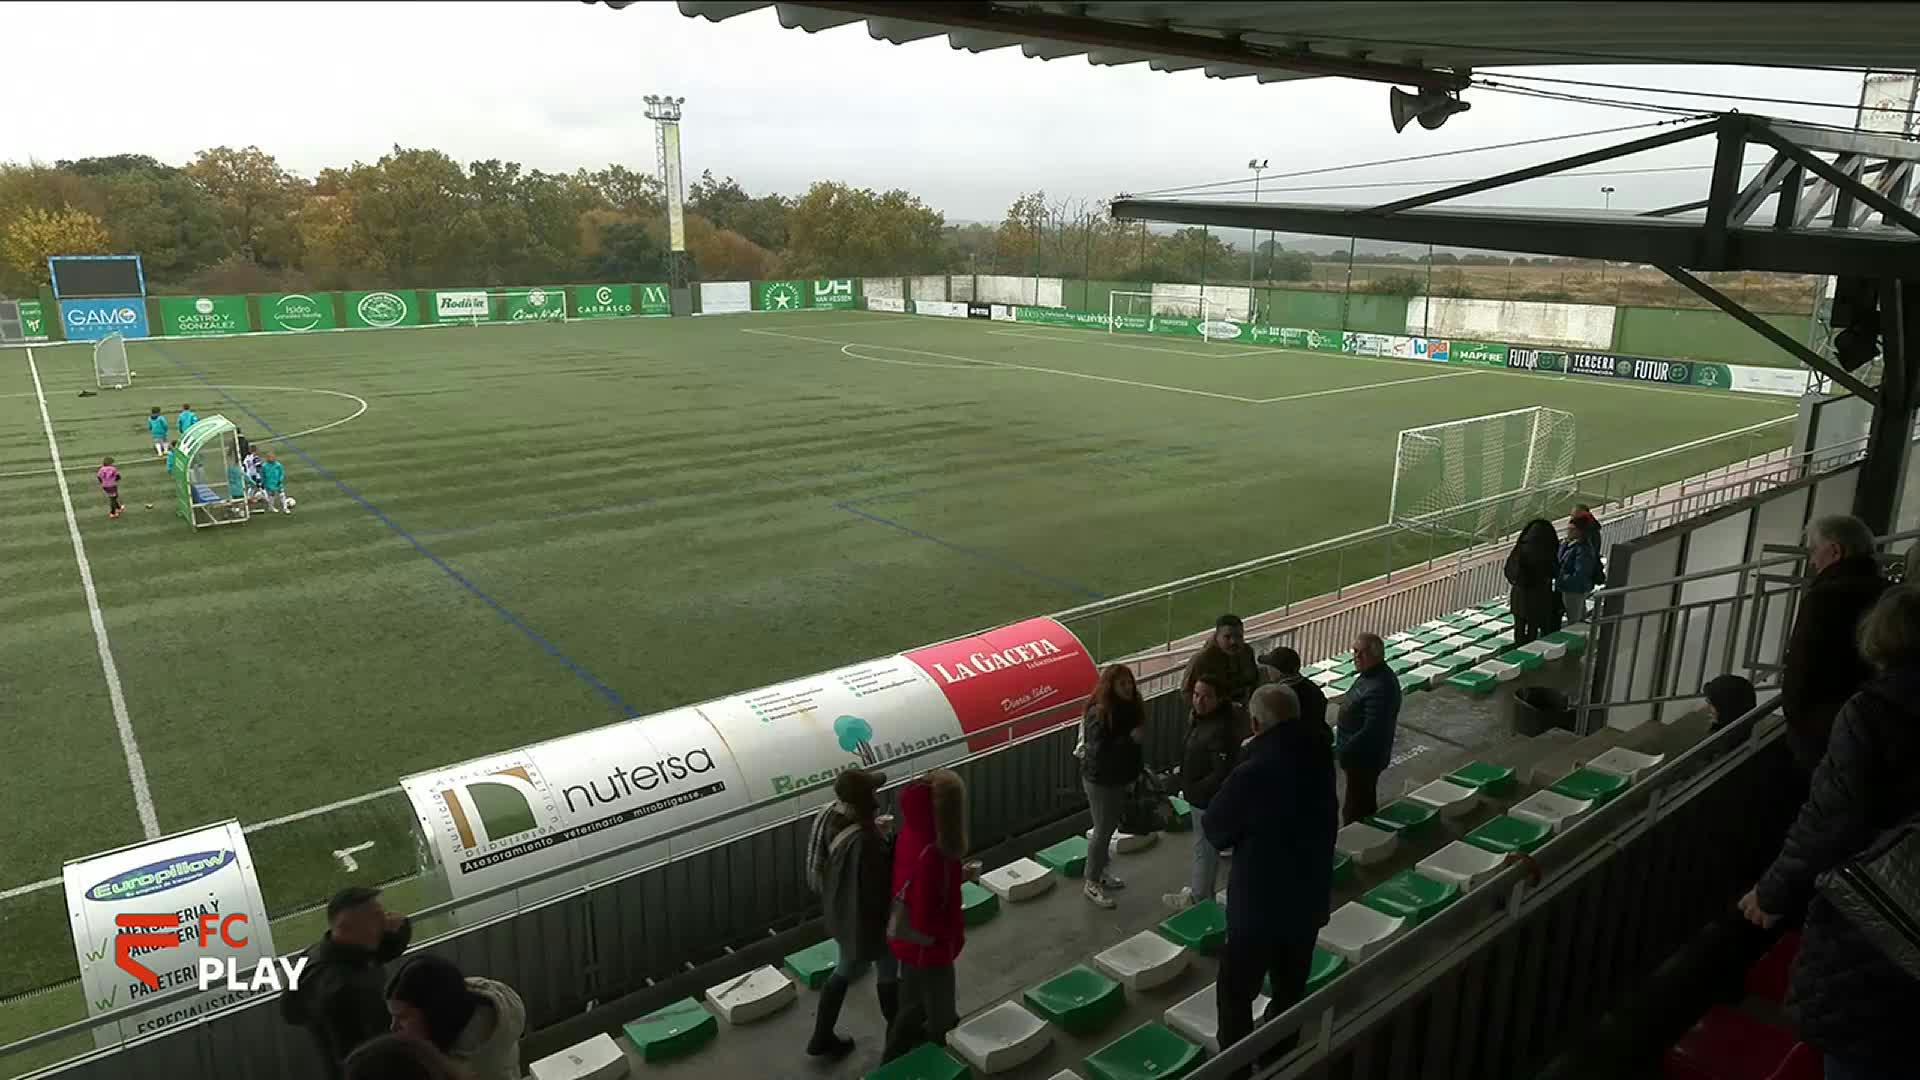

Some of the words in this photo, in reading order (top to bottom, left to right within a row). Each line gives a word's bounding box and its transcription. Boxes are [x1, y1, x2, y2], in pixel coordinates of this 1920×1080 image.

[67, 307, 137, 326] GAMO
[577, 304, 633, 313] CARRASCO
[177, 314, 220, 323] CASTRO
[222, 313, 230, 321] Y
[1459, 350, 1505, 363] MAPFRE
[1573, 354, 1616, 370] TERCERA
[932, 660, 978, 684] LA
[969, 638, 1062, 674] GACETA
[561, 747, 717, 814] nutersa
[464, 836, 554, 873] Asesoramiento
[562, 812, 625, 840] veterinario
[92, 847, 227, 899] Europillow
[210, 898, 221, 912] Y
